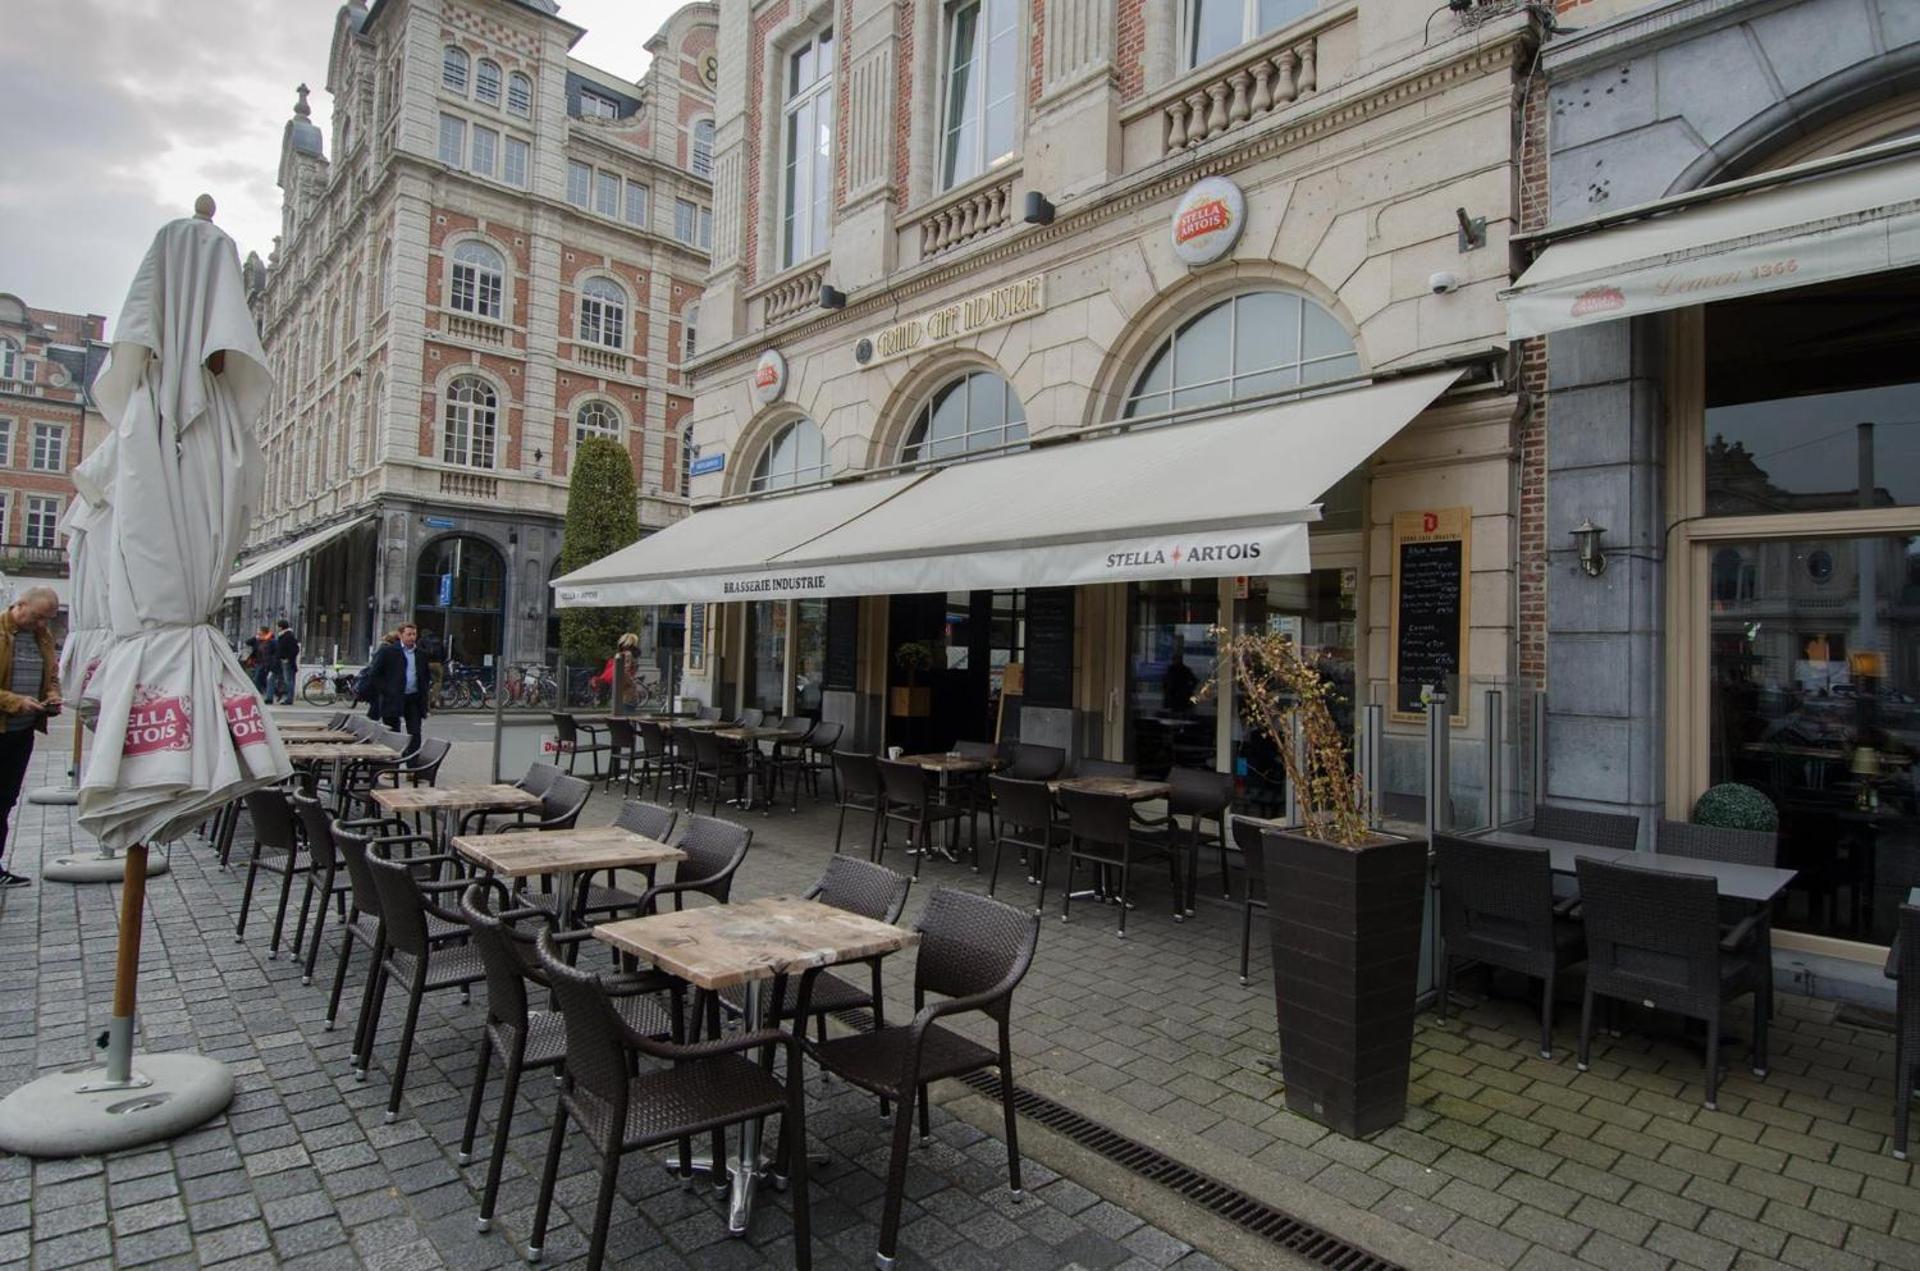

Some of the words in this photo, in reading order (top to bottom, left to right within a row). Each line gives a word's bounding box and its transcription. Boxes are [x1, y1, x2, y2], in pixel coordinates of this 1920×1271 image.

[1181, 205, 1220, 225] STELLA
[1181, 214, 1221, 237] ARTOIS
[1751, 258, 1799, 281] 1366
[877, 321, 922, 357] GRAND
[964, 276, 1041, 332] INDUSTRIE
[1106, 550, 1165, 568] STELLA
[1187, 542, 1261, 562] ARTOIS
[723, 579, 771, 594] BRASSERIE
[772, 575, 826, 591] INDUSTRIE
